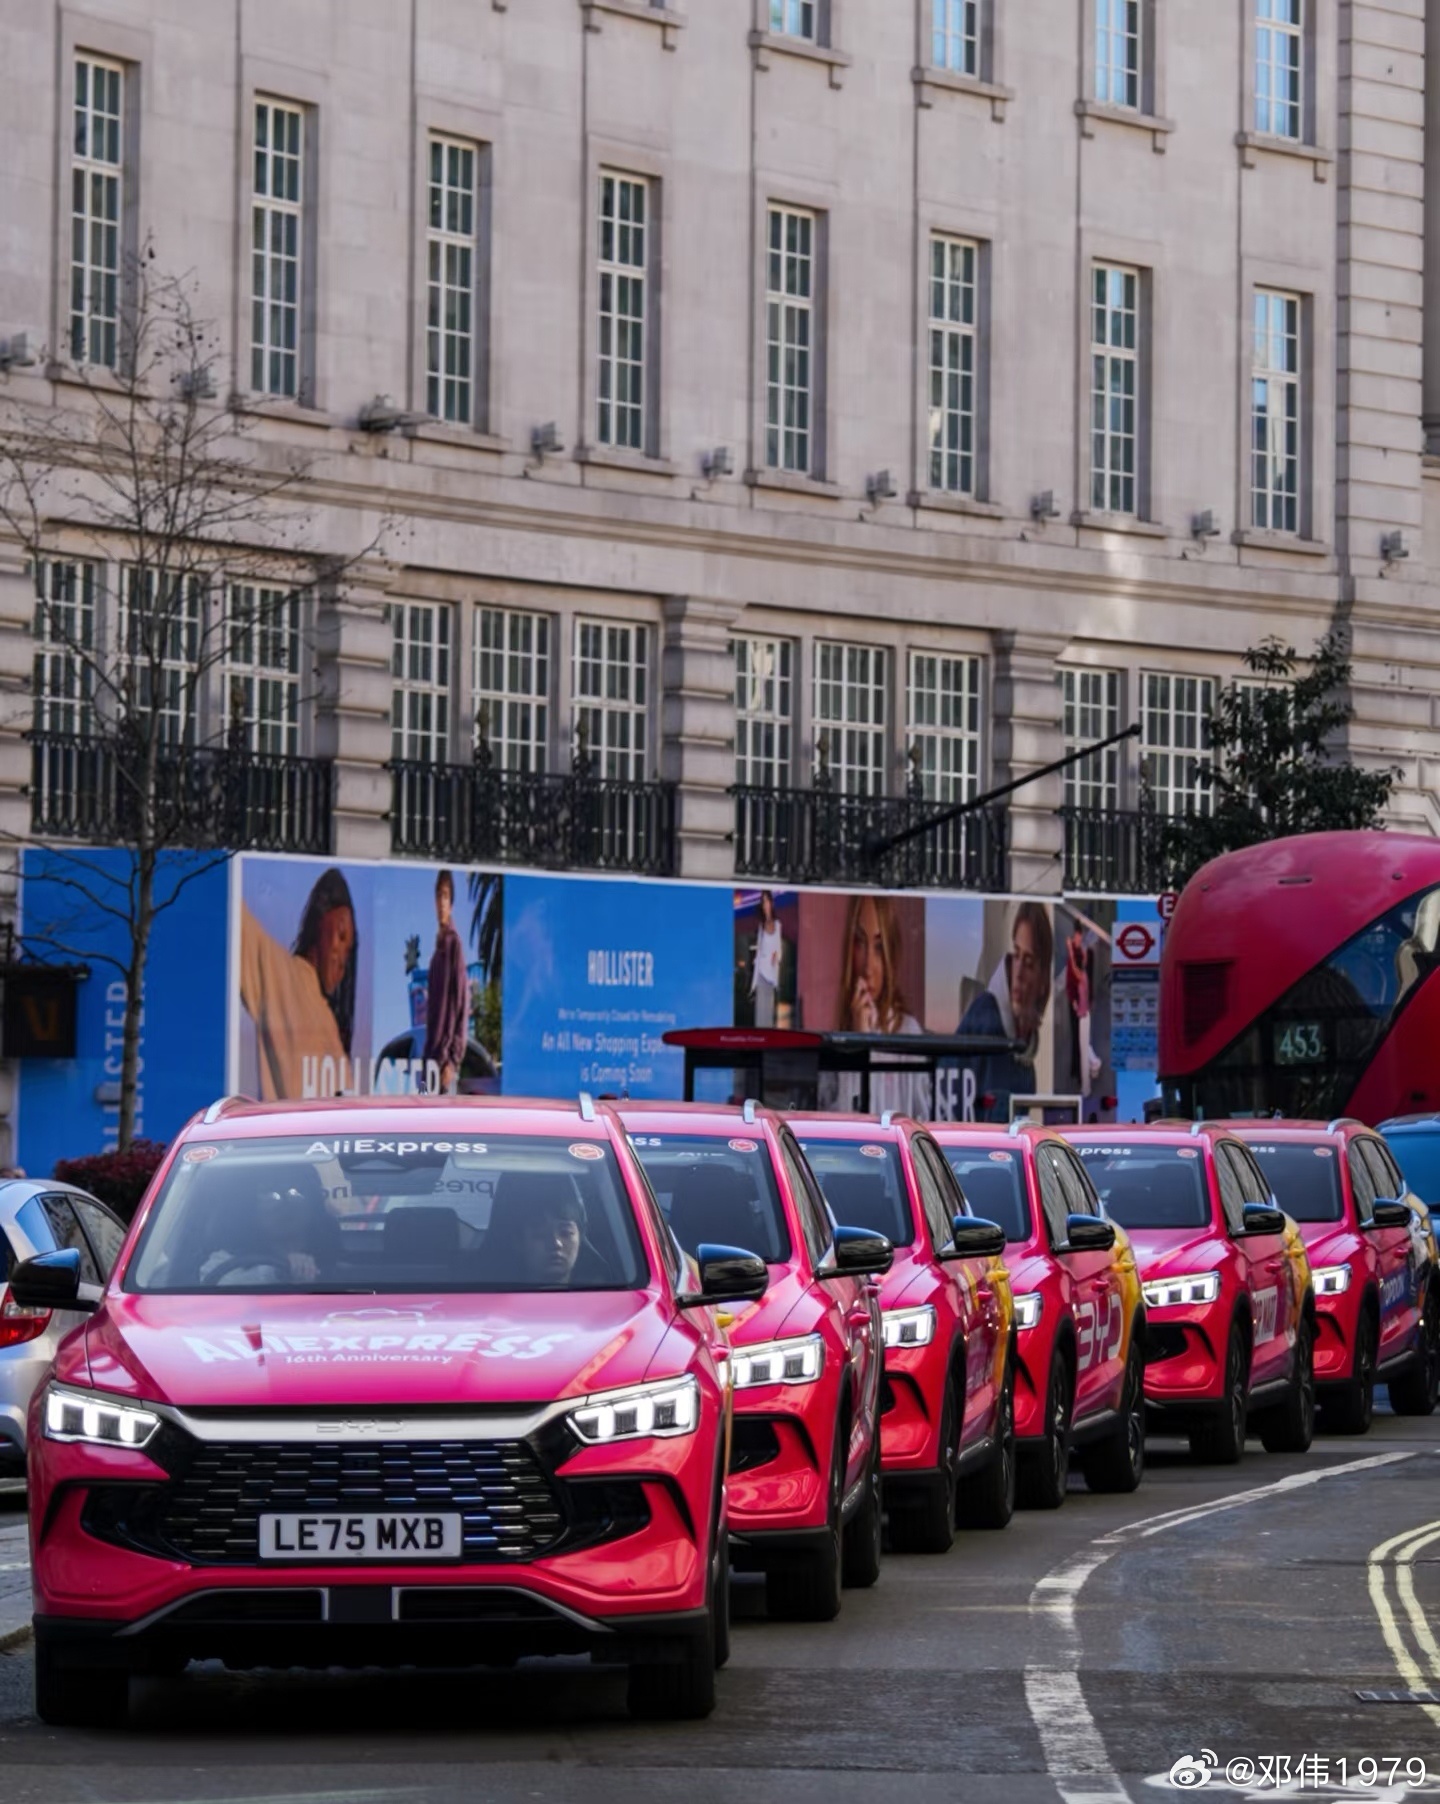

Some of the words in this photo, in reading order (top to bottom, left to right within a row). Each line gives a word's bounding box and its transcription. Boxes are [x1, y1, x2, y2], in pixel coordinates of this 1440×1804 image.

[1162, 895, 1174, 919] E
[587, 949, 655, 987] HOLLISTER
[572, 1032, 593, 1052] New
[595, 1032, 639, 1057] Shopping
[1280, 1026, 1321, 1057] 453
[590, 1062, 627, 1088] Coming
[628, 1062, 653, 1083] Soon
[305, 1139, 489, 1156] AliExpress
[181, 1333, 575, 1363] ALIEXPRESS
[286, 1354, 319, 1364] 16th
[331, 1352, 453, 1364] Anniversary
[316, 1419, 405, 1434] BYD
[274, 1518, 366, 1551] LE75
[376, 1518, 444, 1551] MXB
